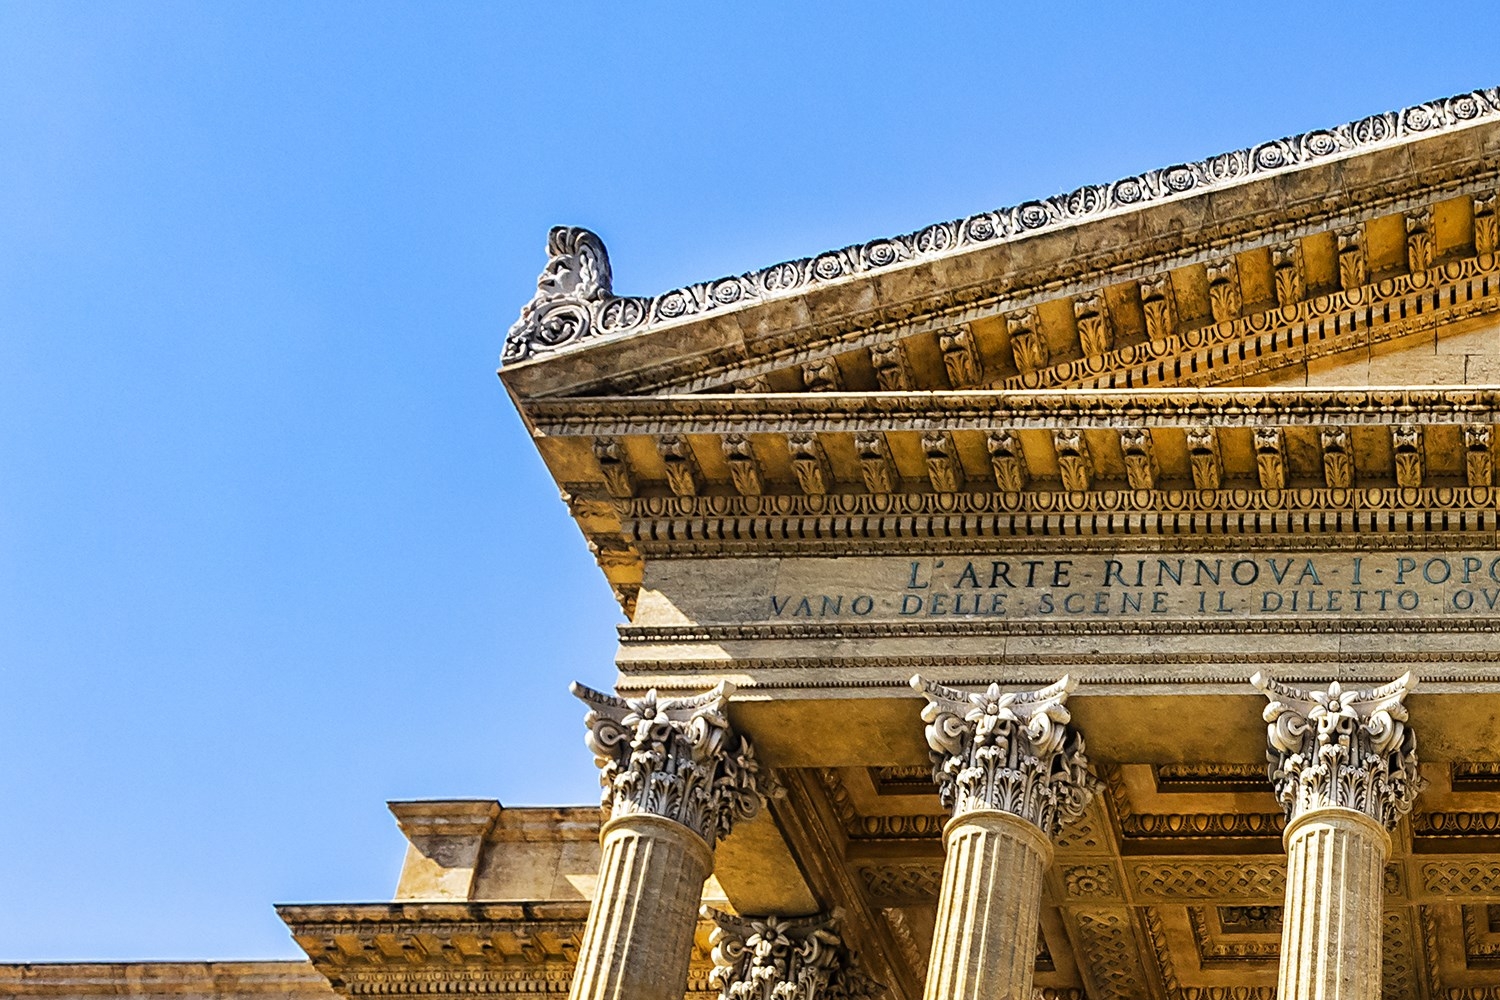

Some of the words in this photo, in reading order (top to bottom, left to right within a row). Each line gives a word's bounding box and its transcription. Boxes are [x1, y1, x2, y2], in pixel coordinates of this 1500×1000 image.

[907, 559, 1074, 589] L'ARTE
[1102, 557, 1323, 588] RINNOVA
[1351, 557, 1363, 585] I
[770, 594, 875, 617] VANO
[898, 593, 1008, 616] DELLE
[1038, 591, 1169, 614] SCENE
[1198, 590, 1234, 613] IL
[1260, 588, 1420, 613] DILETTO
